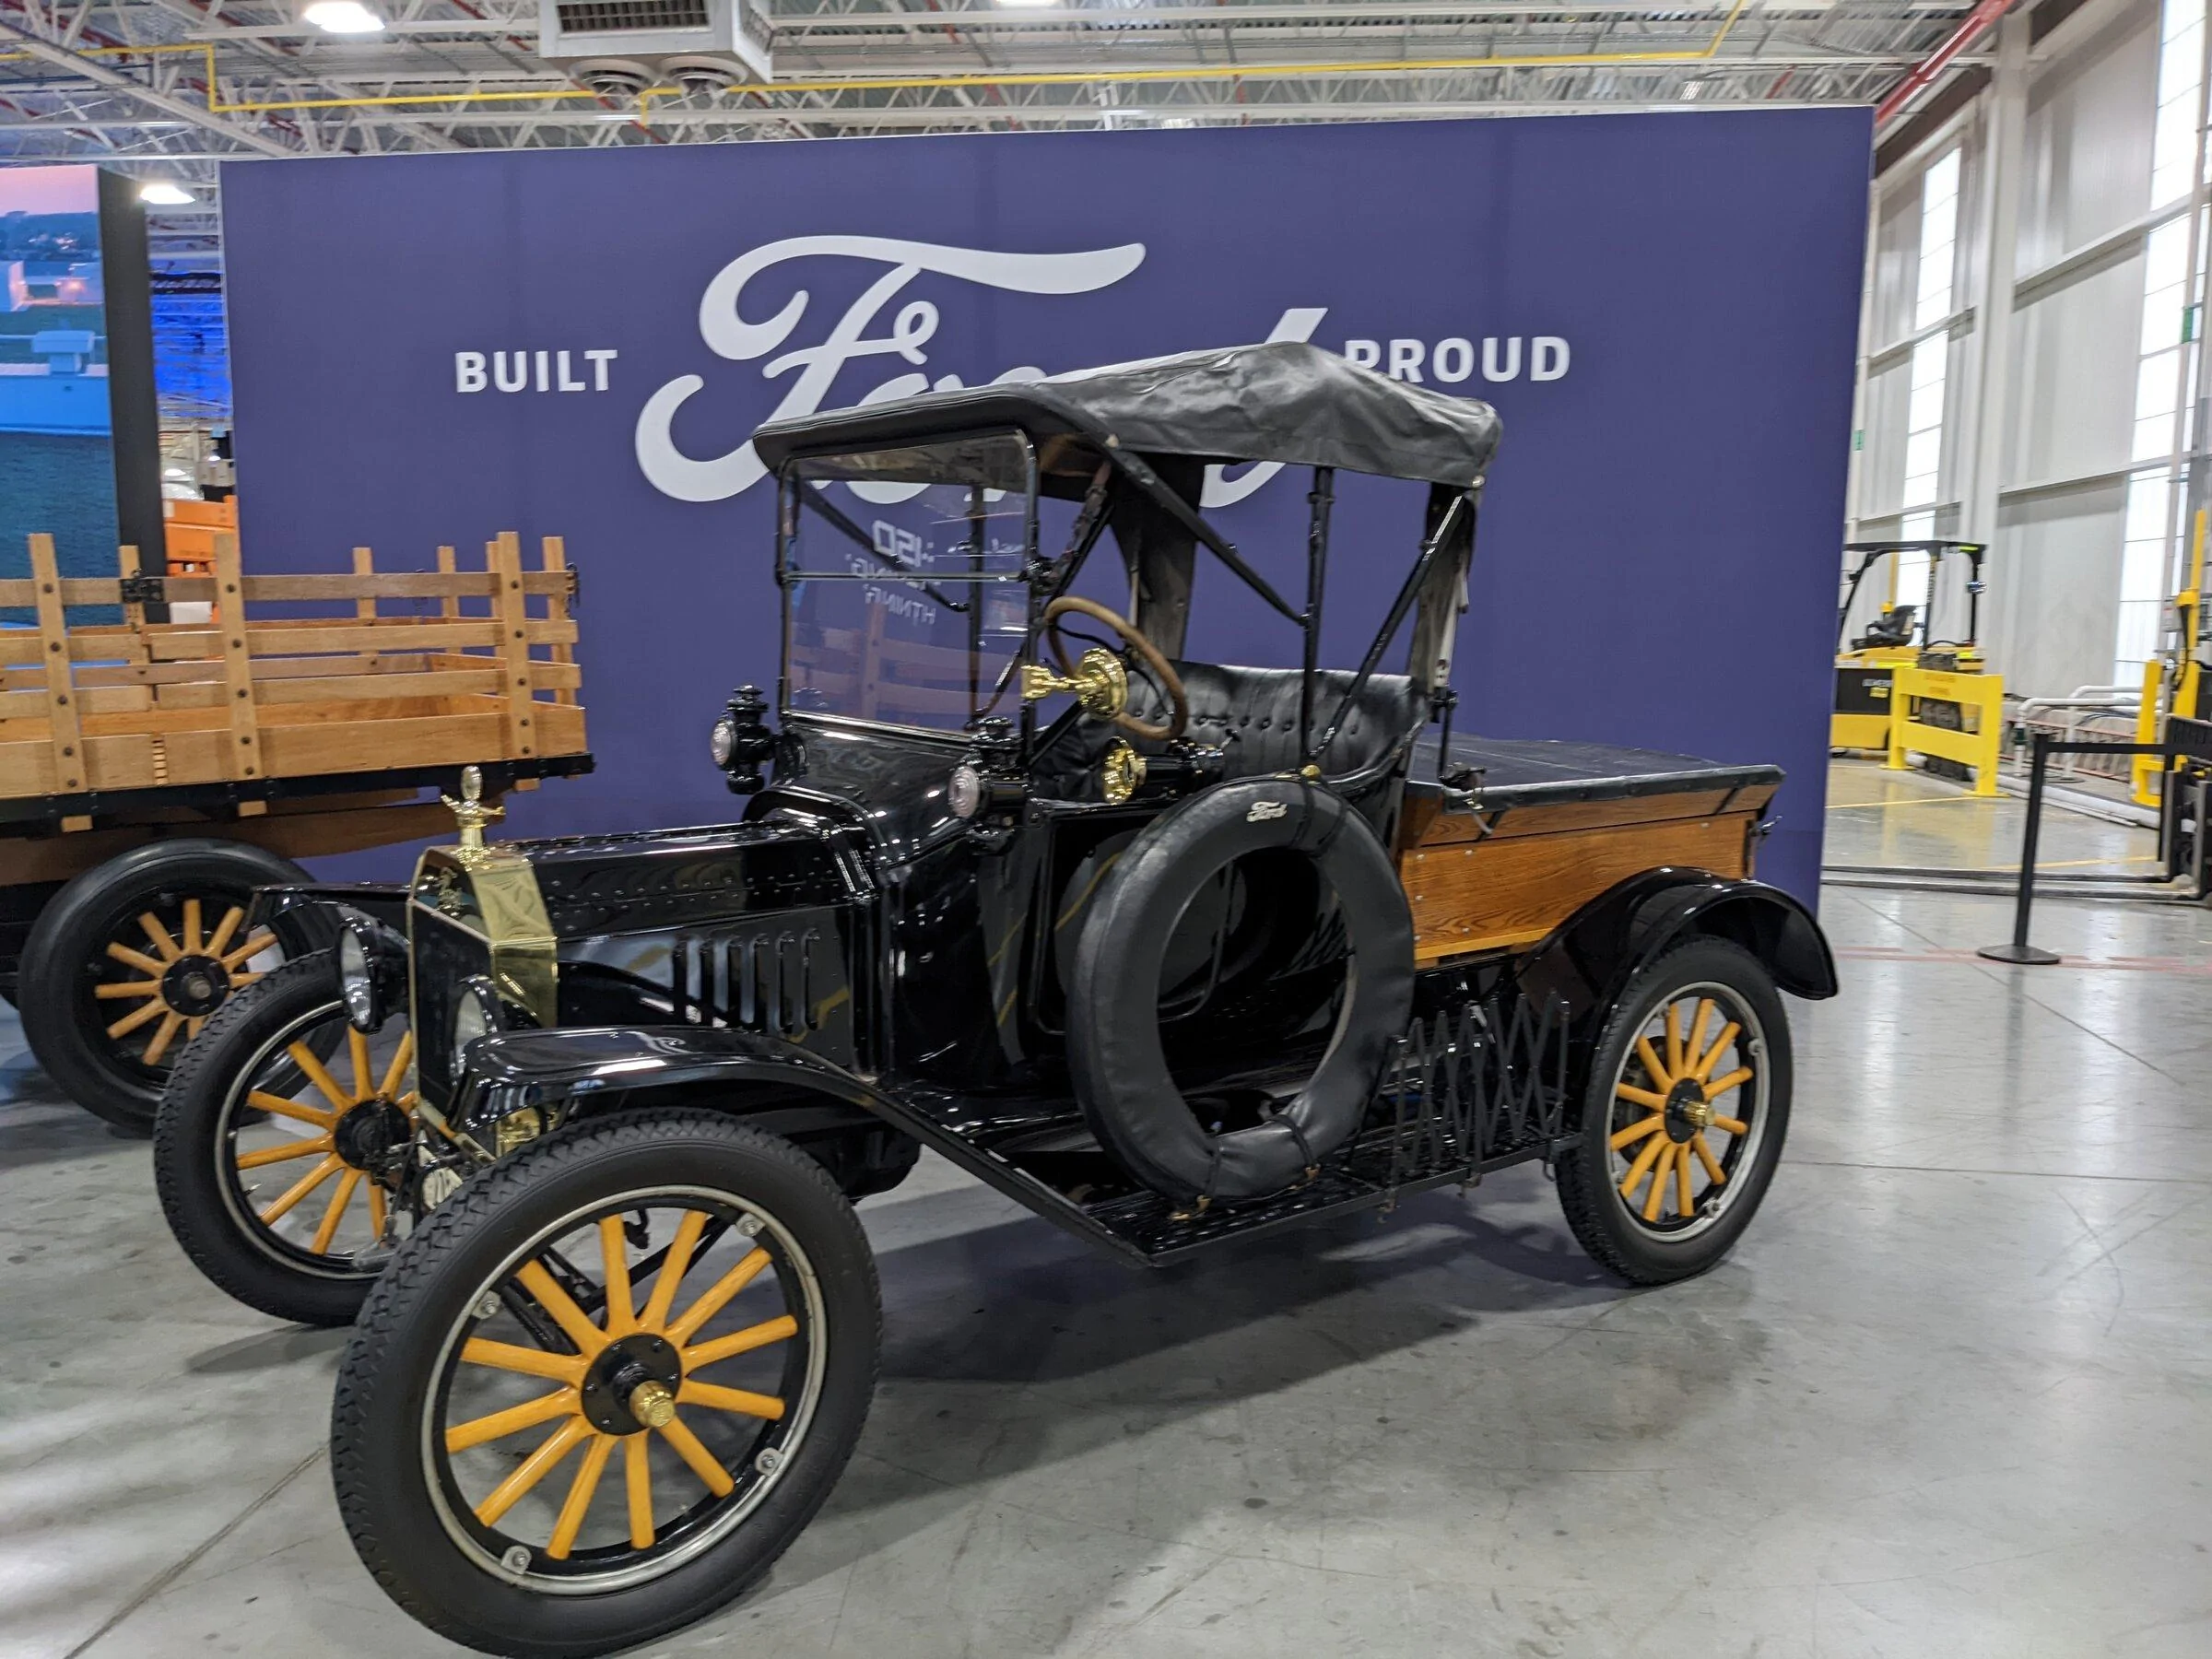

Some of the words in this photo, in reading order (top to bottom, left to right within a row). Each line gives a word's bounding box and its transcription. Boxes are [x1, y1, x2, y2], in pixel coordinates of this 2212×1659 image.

[455, 349, 618, 394] BUILT
[635, 234, 1329, 509] Fo
[1344, 335, 1571, 383] PROUD
[1246, 801, 1288, 823] Ford
